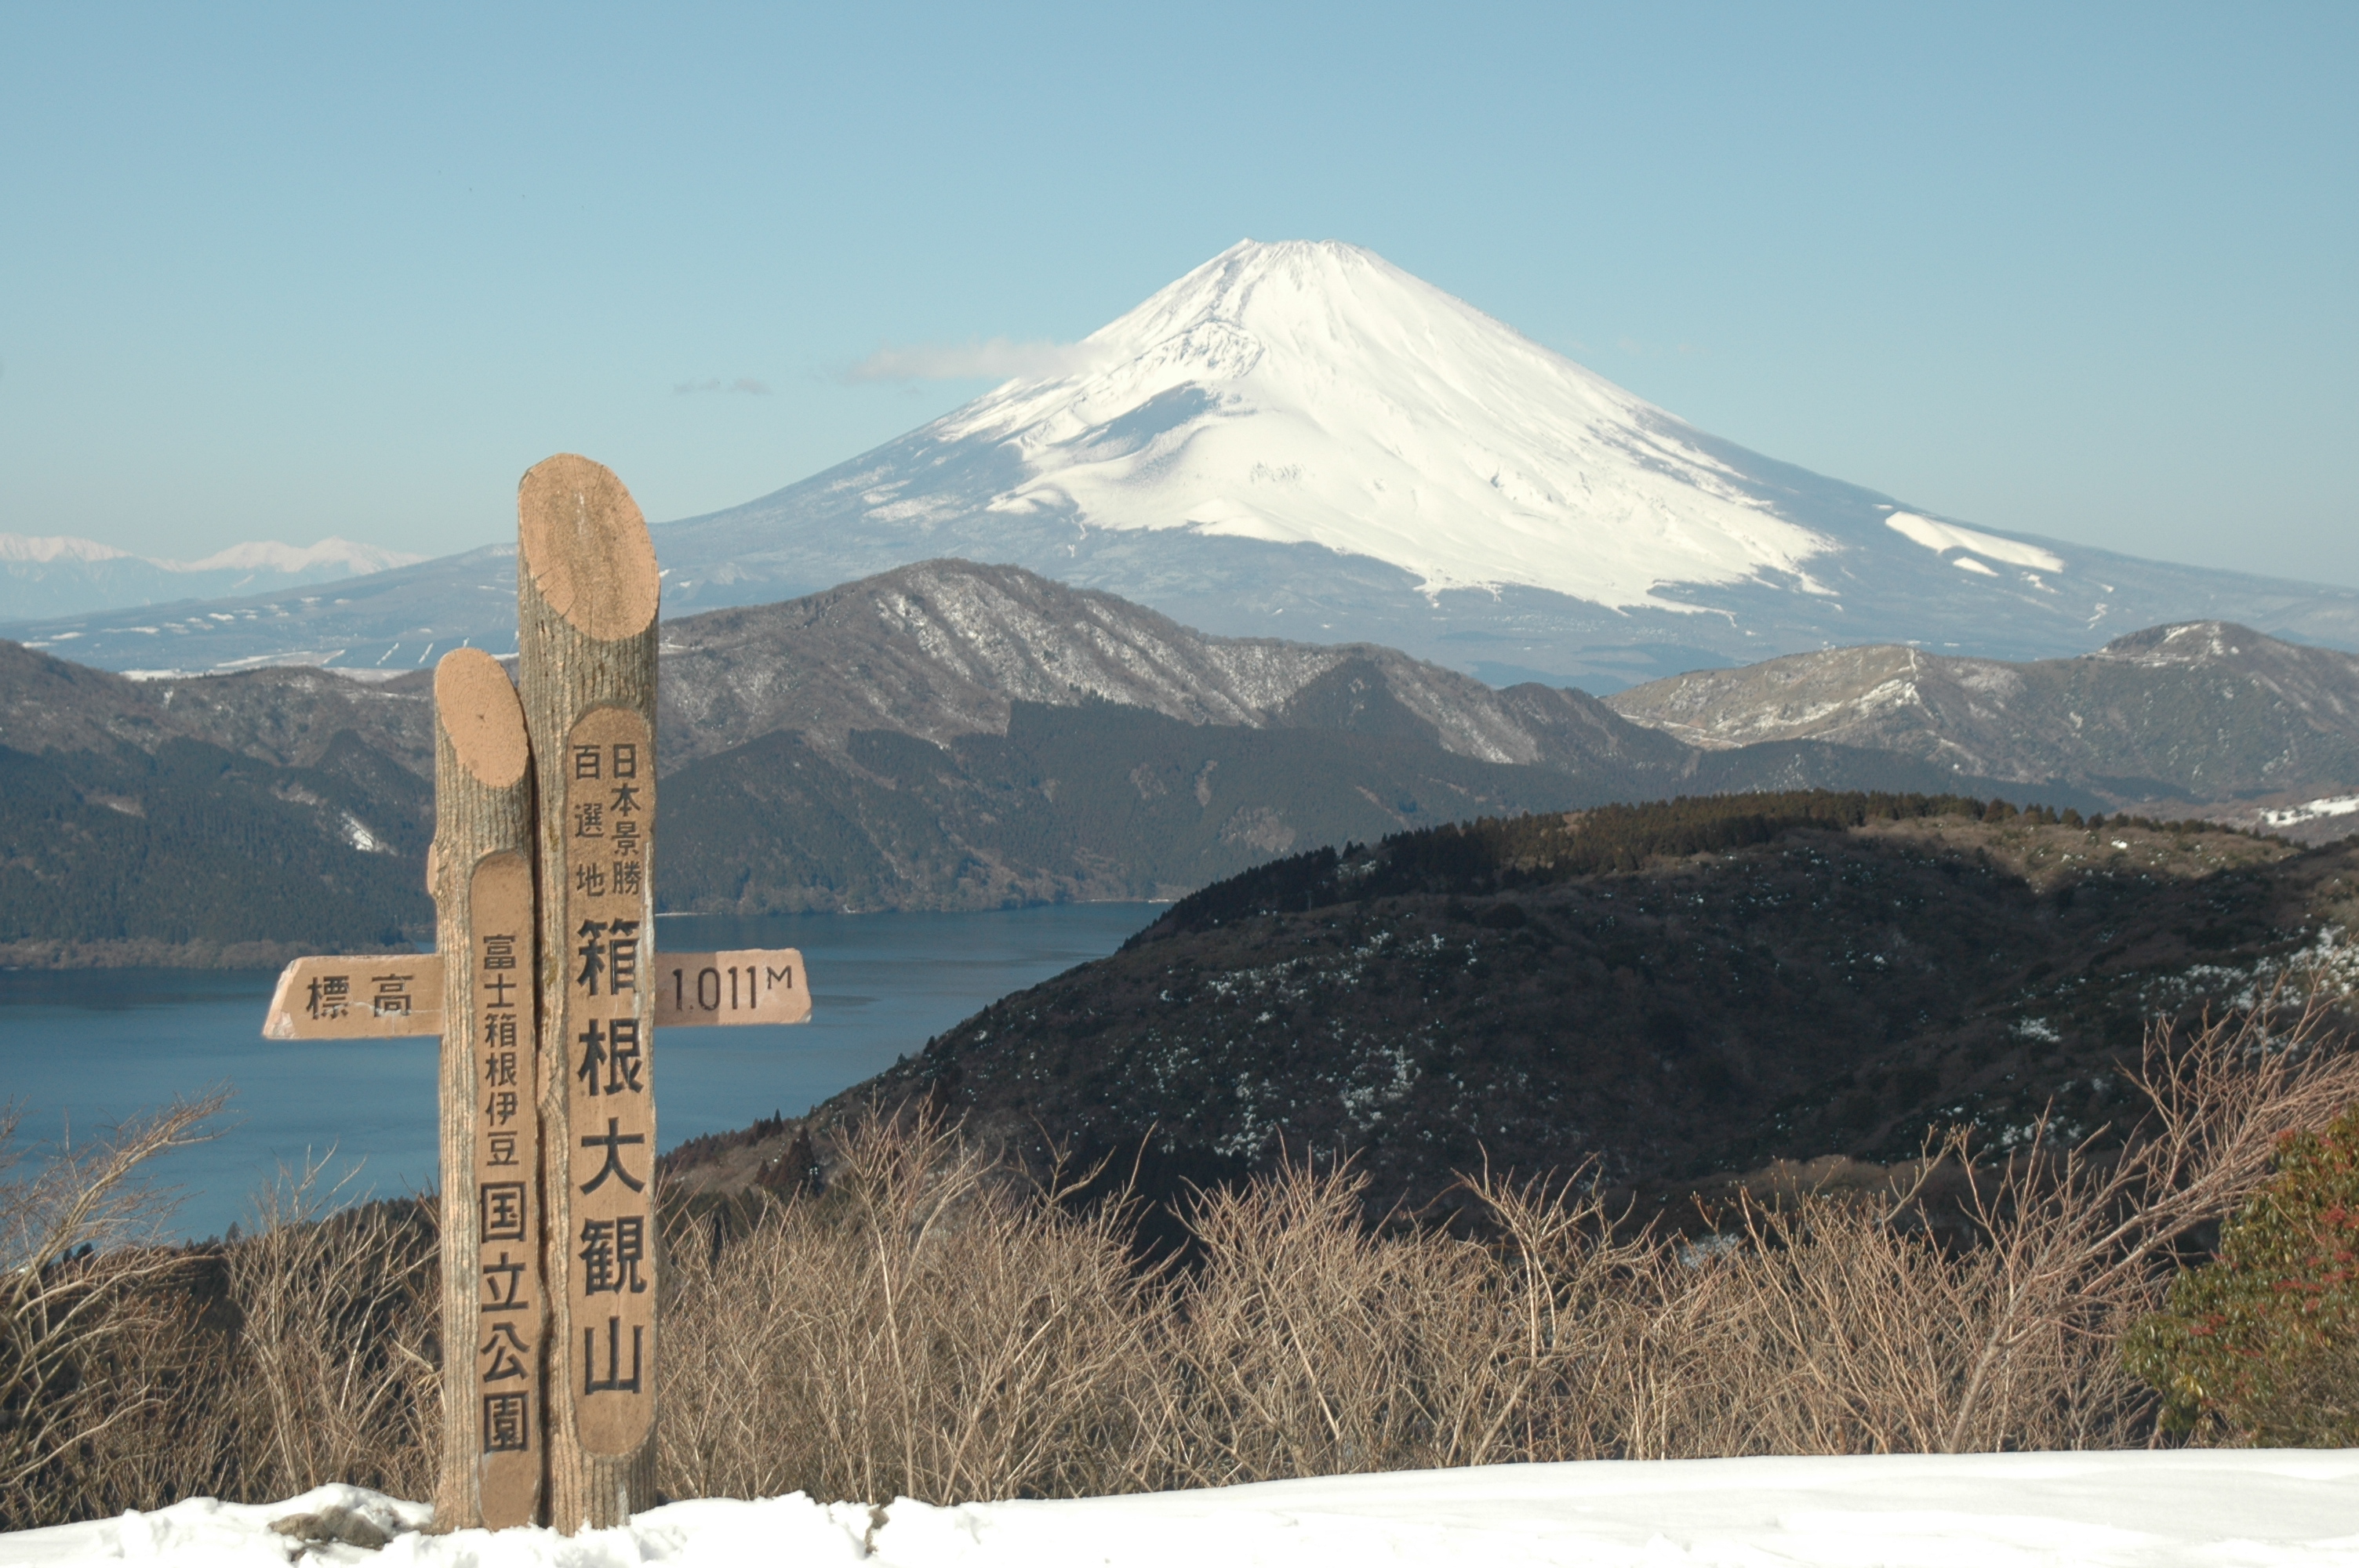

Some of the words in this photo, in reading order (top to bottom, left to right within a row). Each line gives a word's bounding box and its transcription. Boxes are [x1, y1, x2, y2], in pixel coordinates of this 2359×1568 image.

[573, 744, 605, 897] 百選地
[610, 743, 642, 895] 日本景勝
[307, 973, 414, 1020] 標高
[576, 917, 647, 1395] 箱根大観山
